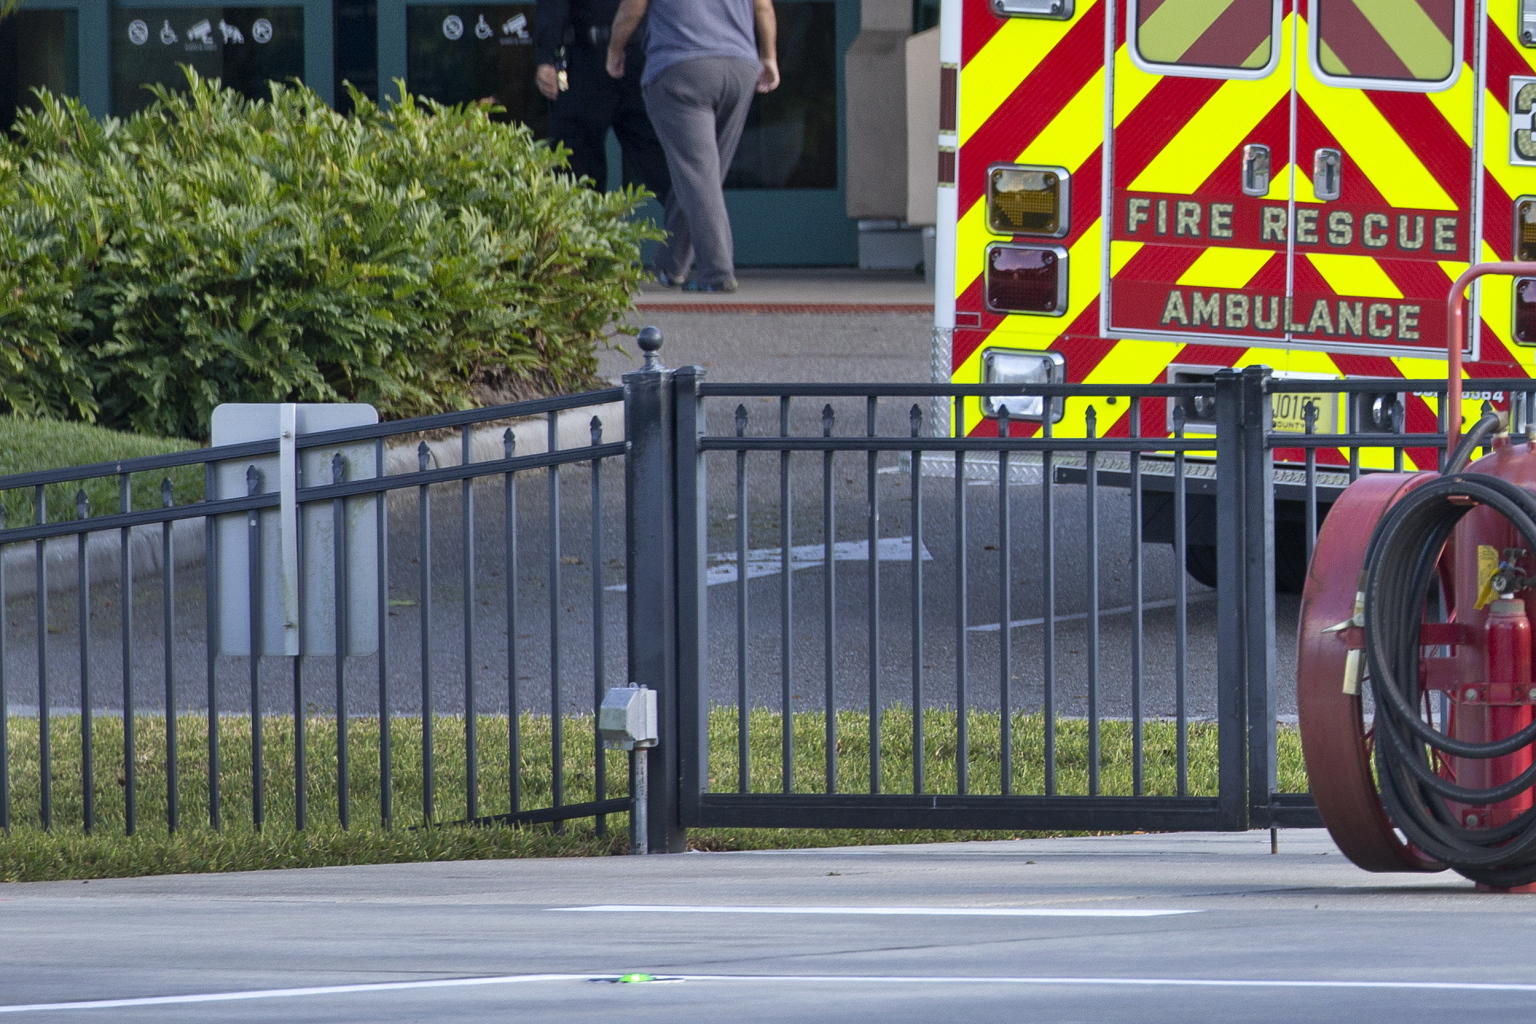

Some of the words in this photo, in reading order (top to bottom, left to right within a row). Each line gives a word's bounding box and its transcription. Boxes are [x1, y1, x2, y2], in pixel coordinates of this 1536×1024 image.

[1126, 198, 1234, 239] FIRE
[1261, 205, 1458, 253] RESCUE
[1160, 290, 1421, 340] AMBULANCE
